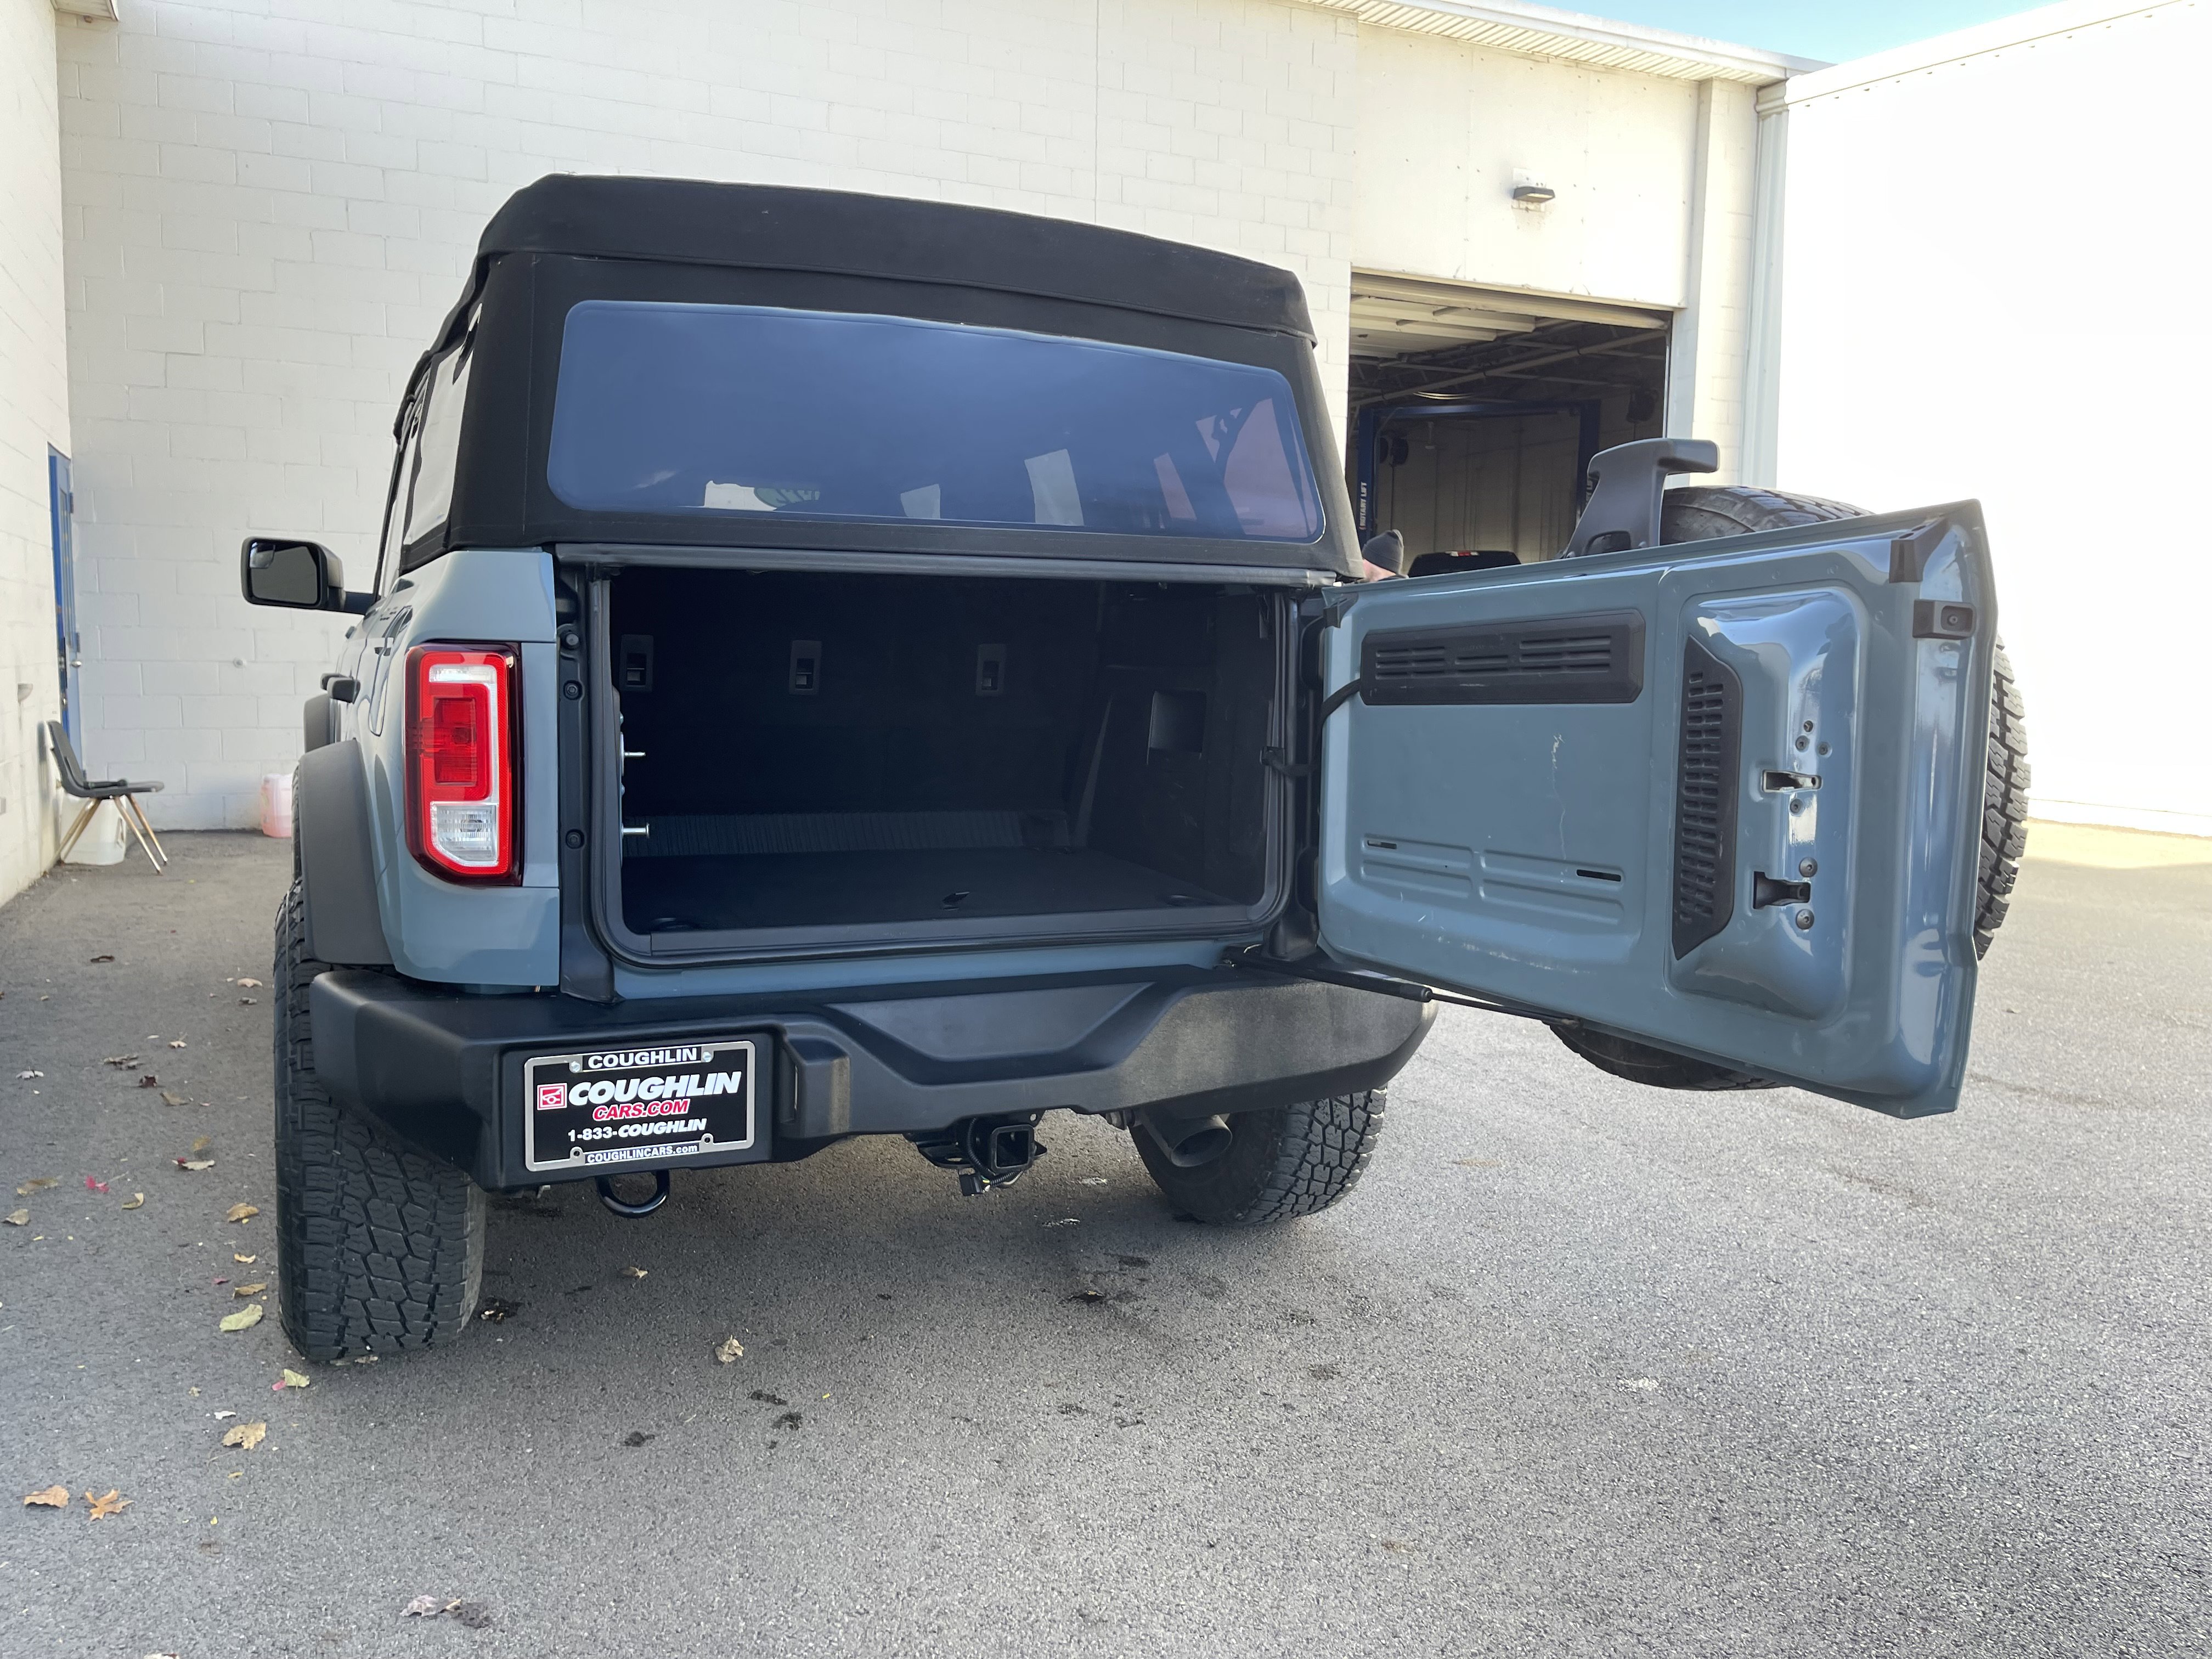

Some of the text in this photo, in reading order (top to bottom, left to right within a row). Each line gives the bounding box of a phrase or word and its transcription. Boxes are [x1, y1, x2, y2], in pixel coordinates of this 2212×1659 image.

[588, 1047, 697, 1069] COUGHLIN
[568, 1071, 742, 1106] COUGHLIN
[592, 1098, 691, 1121] CARS.COM
[568, 1118, 707, 1142] 1-833-COUGHLIN
[587, 1144, 698, 1163] COUGHLINCARS.com
